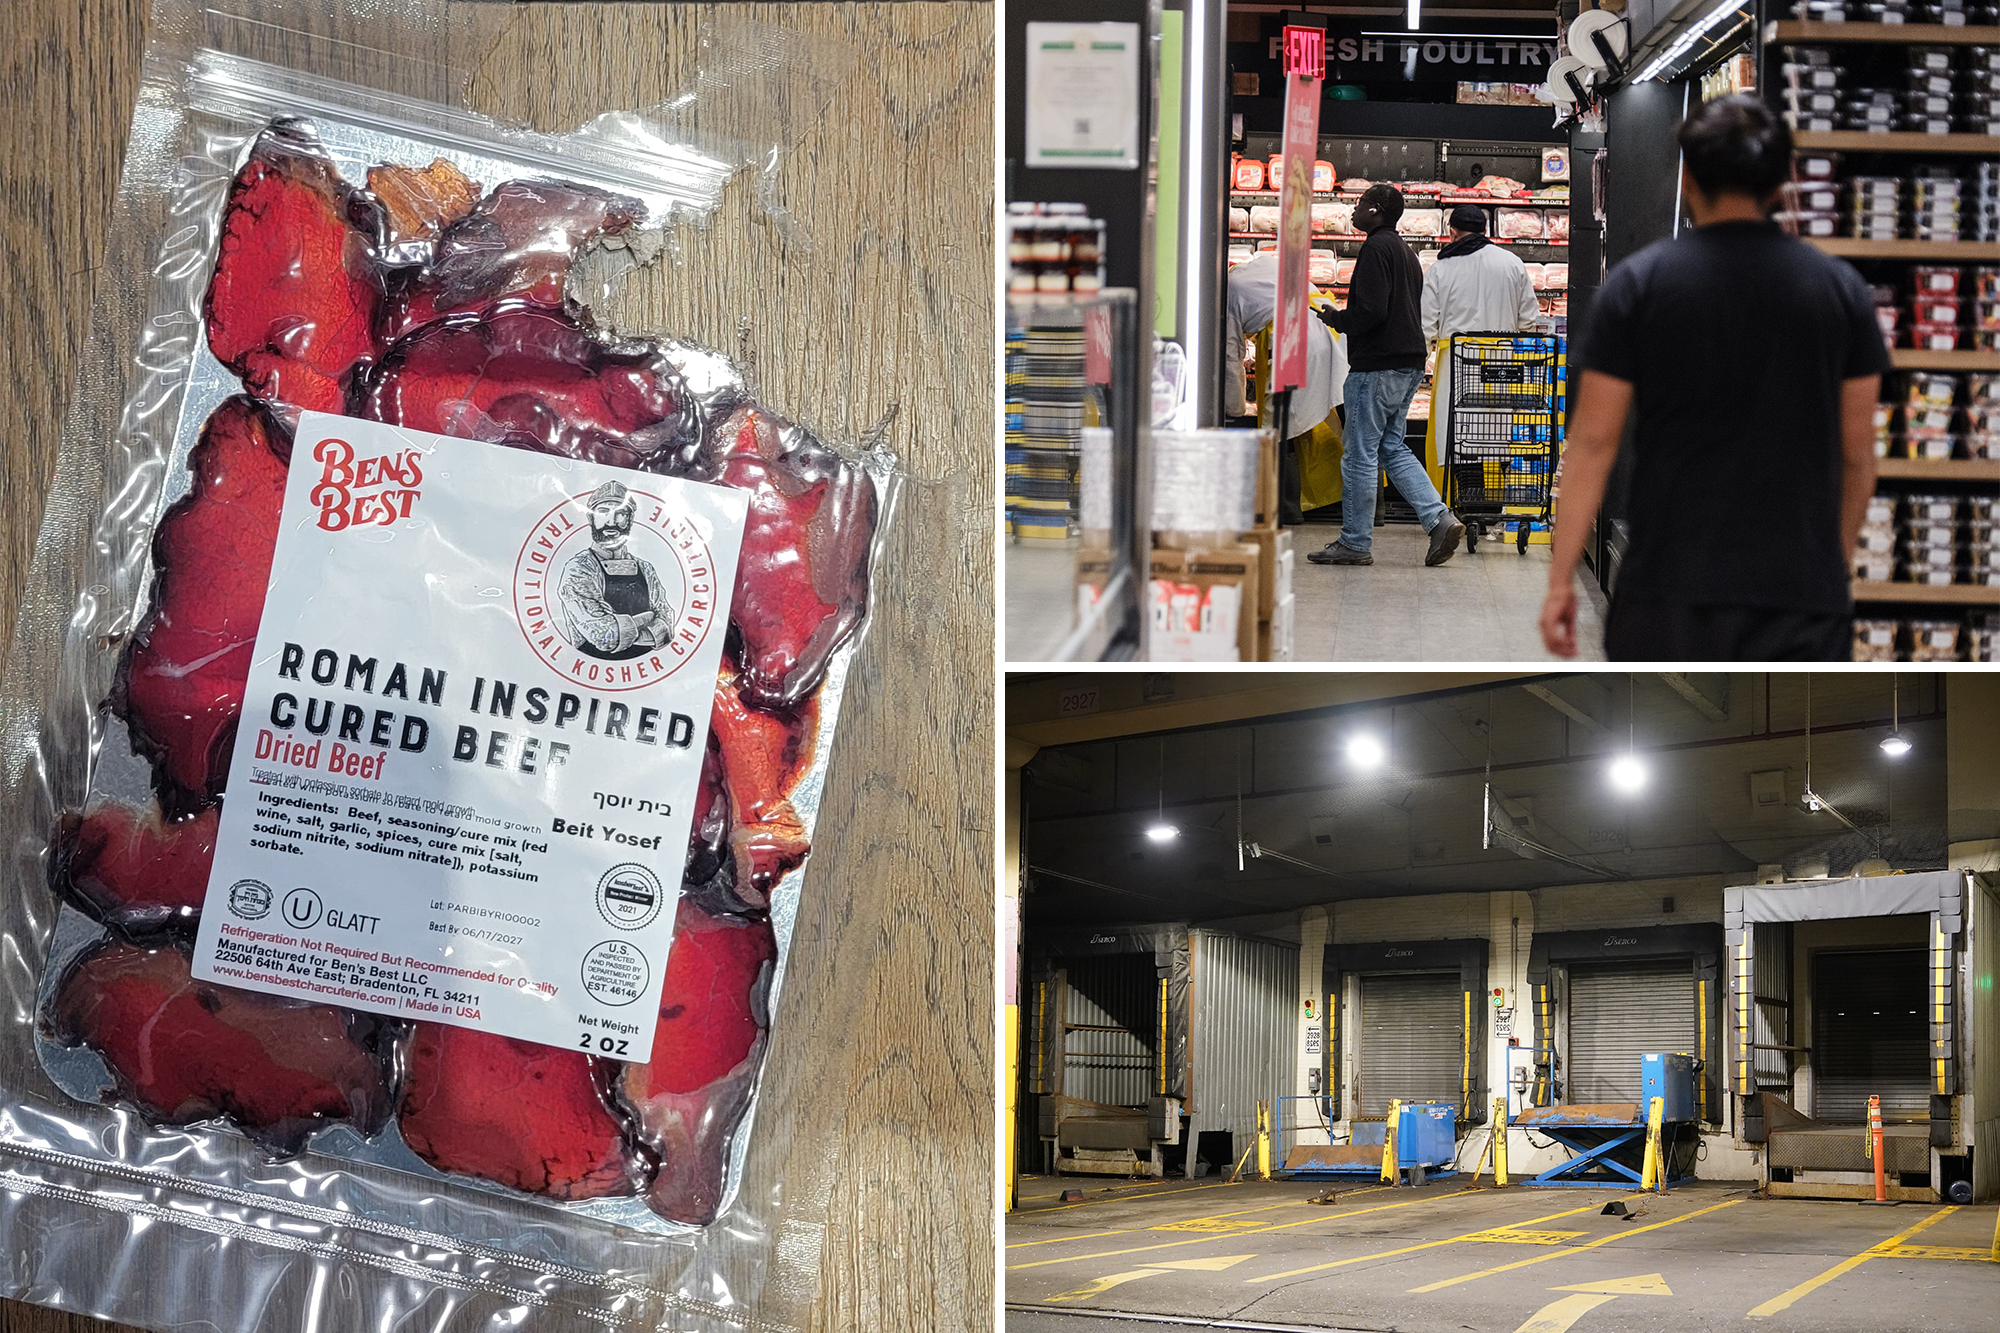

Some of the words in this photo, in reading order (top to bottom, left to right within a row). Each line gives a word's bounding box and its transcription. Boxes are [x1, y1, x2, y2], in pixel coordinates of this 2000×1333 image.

[1269, 36, 1384, 62] FESH
[1400, 39, 1559, 66] POULTRY
[1290, 30, 1320, 76] EXIT
[313, 438, 423, 488] BEN'S
[310, 483, 421, 532] BEST
[524, 512, 573, 662] TRADITIONAL
[572, 656, 664, 684] KOSHER
[278, 642, 448, 707] ROMAN
[470, 676, 695, 751] INSPIRED
[1062, 692, 1097, 712] 2927
[270, 692, 430, 753] CURED
[452, 724, 571, 780] BEEF
[255, 729, 322, 769] Dried
[328, 742, 387, 780] Beef
[593, 791, 632, 810] יוסף
[637, 800, 672, 817] בית
[258, 790, 339, 815] Ingredients:
[348, 806, 382, 825] Beef,
[387, 815, 489, 842] seasoning/cure
[493, 834, 517, 848] mix
[522, 839, 548, 853] (red
[504, 820, 542, 834] growth
[1847, 809, 1884, 824] 2925
[256, 807, 291, 824] wine,
[296, 815, 325, 830] salt,
[329, 821, 371, 839] garlic,
[376, 829, 423, 848] spices,
[428, 838, 458, 852] cure
[462, 845, 486, 858] mix
[489, 848, 522, 867] [salt,
[551, 817, 595, 839] Beit
[602, 826, 662, 851] Yosef
[1593, 828, 1625, 843] 2926
[249, 839, 304, 856] sorbate.
[252, 823, 302, 840] sodium
[306, 831, 350, 850] nitrite,
[355, 840, 404, 858] sodium
[408, 850, 464, 871] nitrate]),
[469, 861, 539, 883] potassium
[430, 899, 445, 911] Lot:
[618, 904, 637, 915] 2021
[327, 909, 381, 935] GLATT
[429, 920, 447, 934] Best
[462, 927, 523, 946] 06/17/2027
[217, 937, 306, 963] Manufactured
[309, 954, 328, 967] for
[331, 958, 366, 975] Ben's
[369, 966, 399, 981] Best
[402, 974, 428, 986] LLC
[220, 923, 297, 947] Refrigeration
[300, 938, 322, 952] Not
[325, 942, 379, 961] Required
[381, 952, 402, 966] But
[404, 957, 496, 983] Recommended
[498, 973, 515, 987] for
[598, 951, 635, 964] INSPECTED
[608, 943, 630, 956] U.S.
[215, 949, 253, 966] 22506
[256, 956, 283, 972] 64th
[286, 963, 311, 976] Ave
[314, 967, 346, 985] East;
[350, 974, 420, 998] Bradenton,
[424, 987, 440, 999] FL
[443, 990, 480, 1006] 34211
[587, 965, 632, 980] DEPARTMENT
[632, 973, 642, 981] OF
[590, 958, 604, 967] AND
[605, 960, 632, 972] PASSED
[632, 965, 642, 974] BY
[213, 964, 396, 1006] www.bensbestcharcuterie.com
[405, 998, 439, 1013] Made
[441, 1003, 453, 1015] in
[455, 1006, 482, 1021] USA
[587, 981, 608, 993] EST.
[609, 985, 637, 999] 46146
[590, 974, 636, 989] AGRICULTURE
[578, 1013, 598, 1027] Net
[601, 1018, 640, 1035] Weight
[579, 1032, 592, 1049] 2
[599, 1036, 630, 1056] OZ
